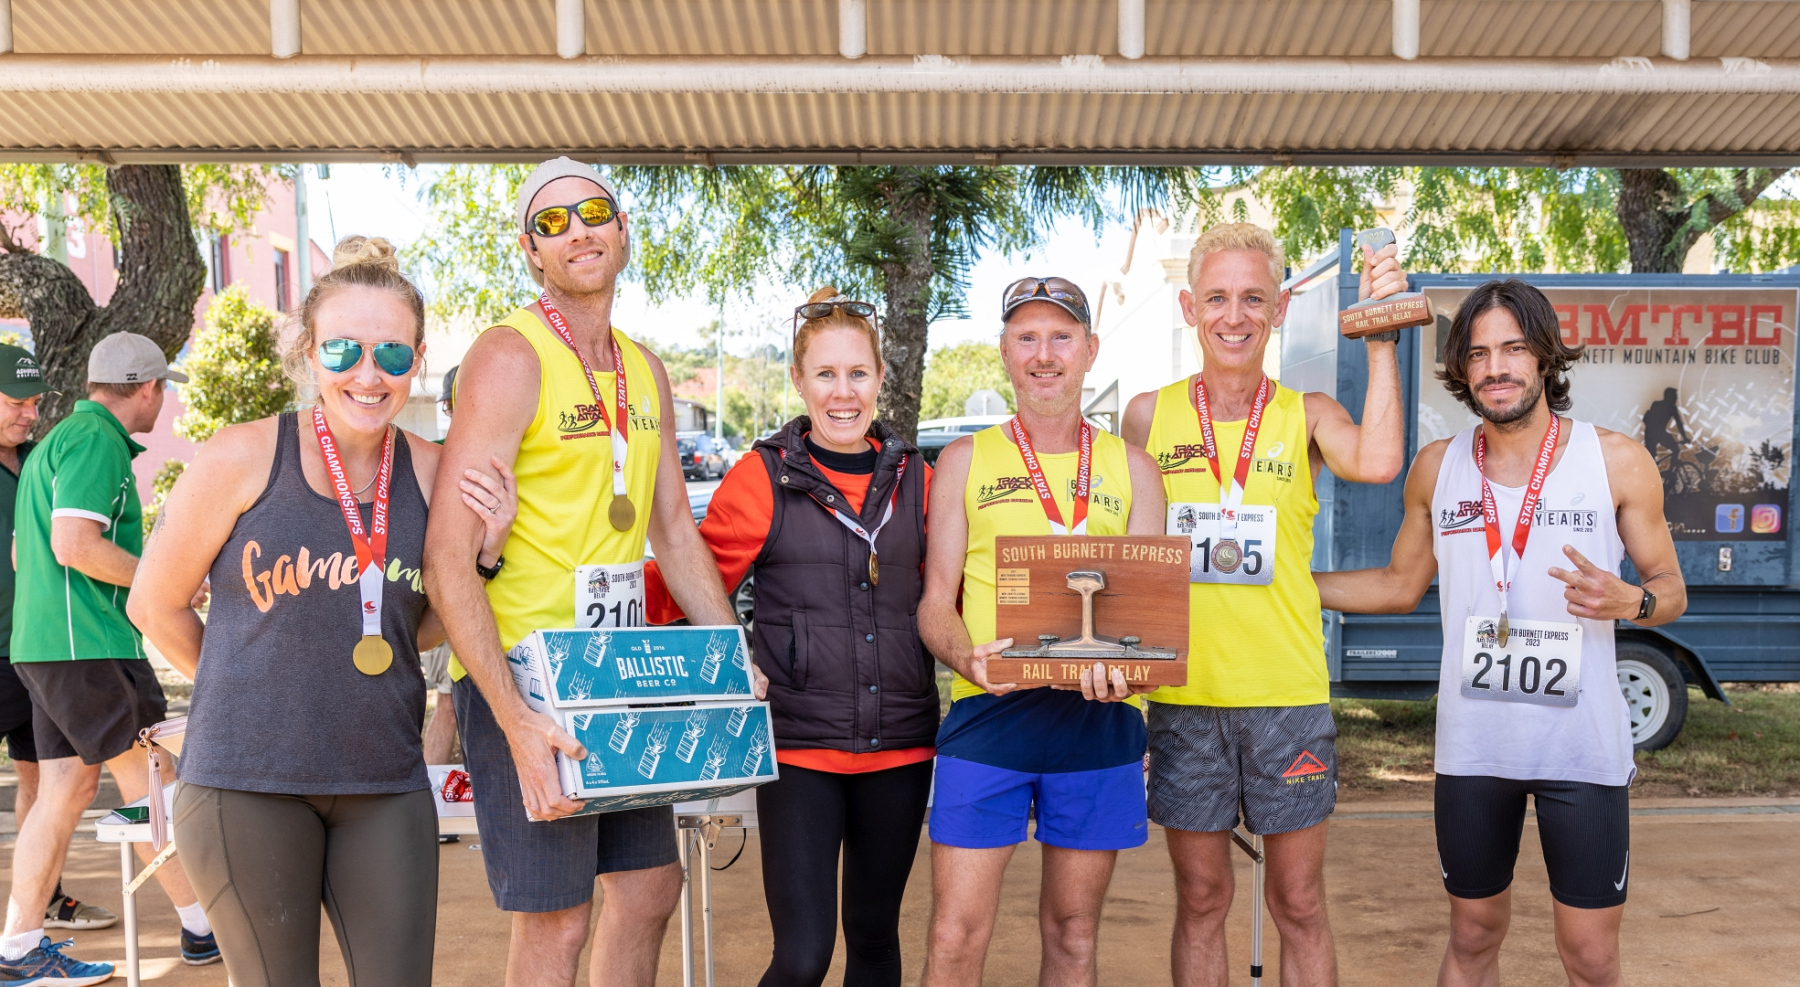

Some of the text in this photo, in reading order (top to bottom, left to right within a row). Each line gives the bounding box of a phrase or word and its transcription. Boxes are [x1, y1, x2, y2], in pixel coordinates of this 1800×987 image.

[1342, 300, 1424, 324] SOUTH BURNETT EXPRESS
[1355, 311, 1412, 329] RAIL TRAIL RELAY
[1623, 348, 1697, 365] MOUNTAIN
[1705, 348, 1737, 365] BIKE
[1745, 348, 1781, 365] CLUB
[618, 376, 627, 410] STATE
[573, 403, 600, 412] TRAC
[577, 411, 603, 421] ATTAC
[1196, 384, 1217, 459] CHAMPIONSHIPS
[1174, 444, 1206, 452] TRACK
[1241, 429, 1257, 460] STATE
[313, 404, 363, 535] TATE CHAMPIONSHIPS
[1078, 426, 1090, 497] CHAMPIONSHIPS
[1256, 461, 1293, 477] EARS
[994, 482, 1035, 491] ATTACK
[996, 476, 1032, 484] TRACK
[1032, 471, 1051, 500] STATE
[1070, 492, 1121, 511] YARS
[1457, 500, 1484, 509] TRAC
[1520, 492, 1537, 526] STATE
[374, 500, 388, 535] STATE
[1198, 511, 1216, 521] SOUTH
[1241, 513, 1264, 523] EXPRESS
[1456, 507, 1484, 518] ATTAC
[1535, 512, 1594, 527] YEARS
[1002, 543, 1183, 565] SOUTH BURNETT EXPRESS
[1518, 630, 1544, 639] BURNETT
[1544, 631, 1569, 641] EXPRESS
[1525, 638, 1540, 647] 2023
[616, 655, 689, 680] BALLISTIC
[1022, 663, 1053, 680] RAIL
[1471, 652, 1567, 696] 2102
[636, 680, 661, 688] BEER
[1307, 773, 1326, 782] TRAIL
